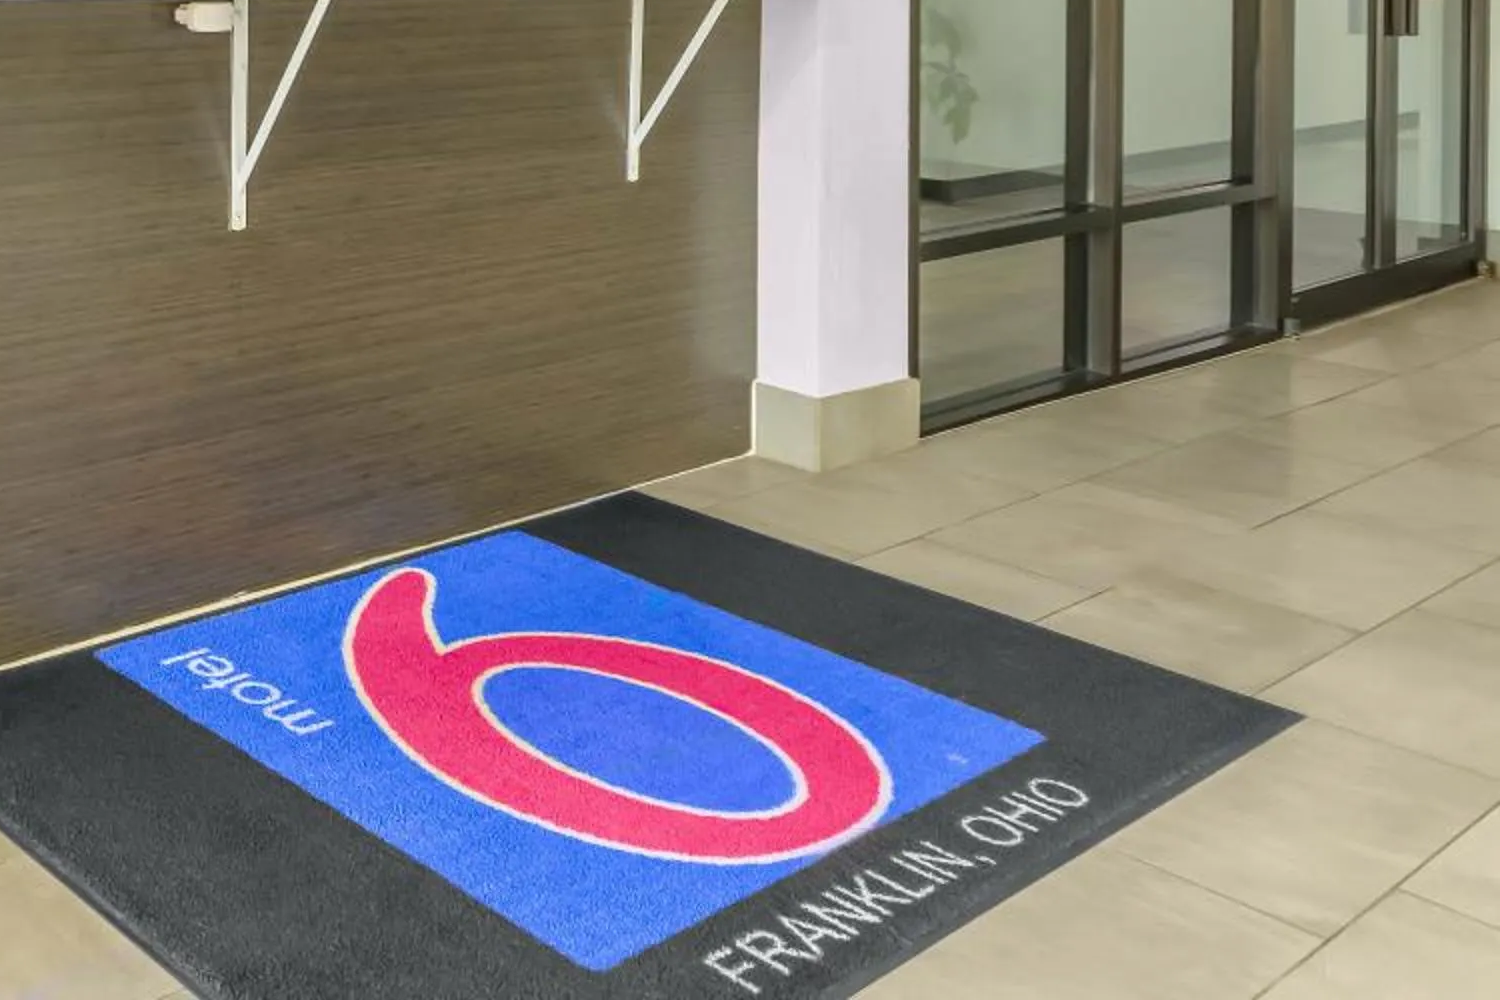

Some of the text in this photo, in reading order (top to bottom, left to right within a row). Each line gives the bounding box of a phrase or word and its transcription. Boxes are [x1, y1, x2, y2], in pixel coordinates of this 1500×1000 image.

[159, 647, 336, 737] motel
[342, 565, 894, 865] 6
[702, 777, 1091, 995] FRANKLIN, OHIO
